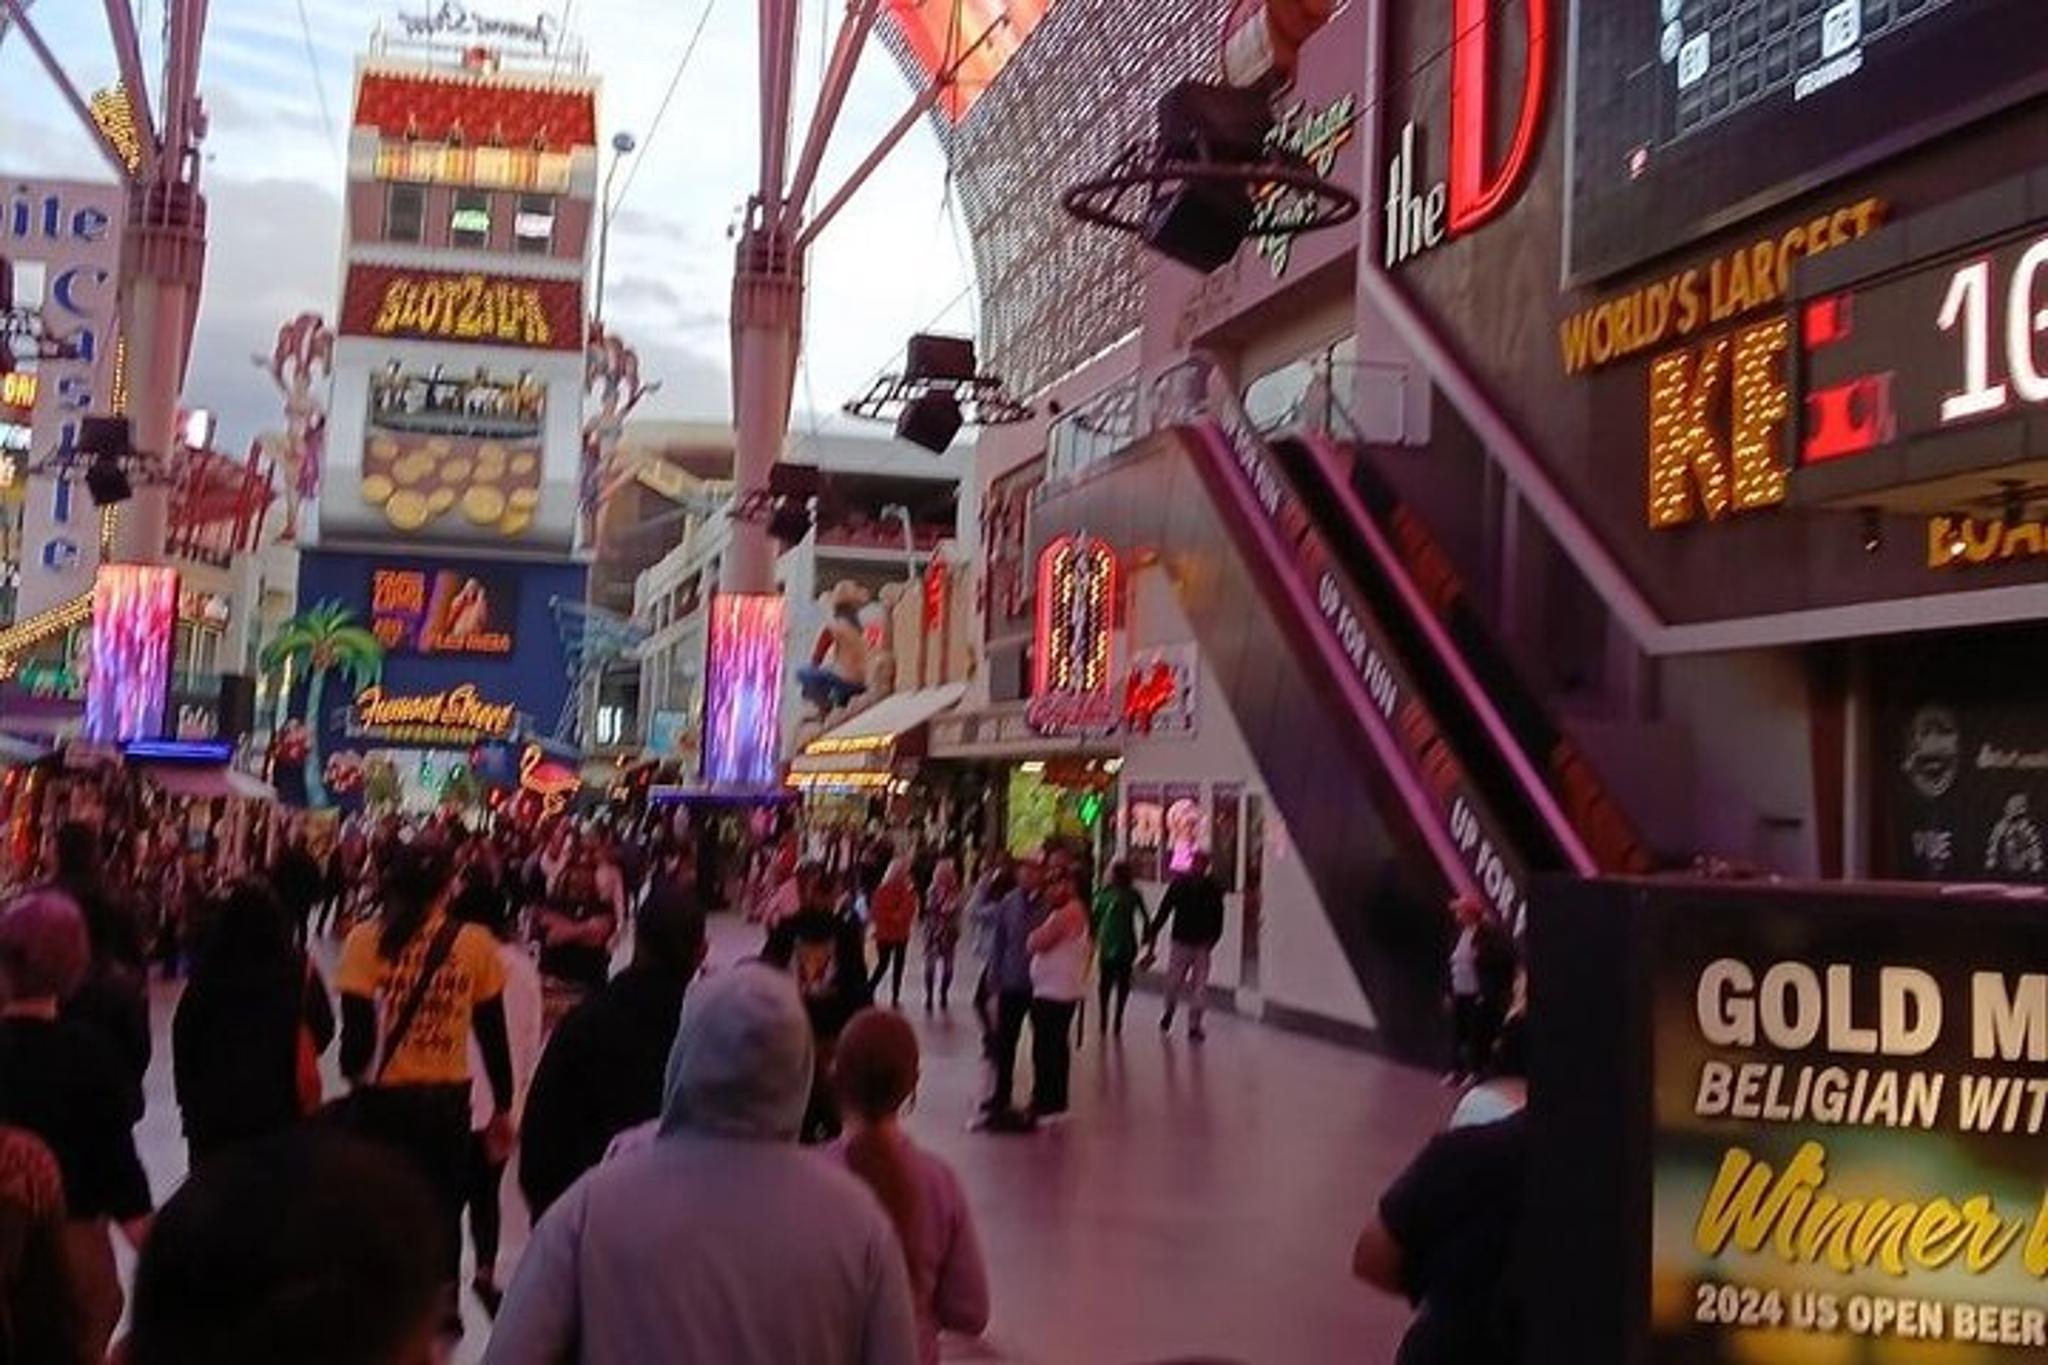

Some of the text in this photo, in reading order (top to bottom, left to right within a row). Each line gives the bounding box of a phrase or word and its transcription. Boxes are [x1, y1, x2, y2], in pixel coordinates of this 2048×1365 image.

[1385, 120, 1446, 270] the
[1449, 0, 1549, 238] D
[1562, 268, 1699, 376] WORLD'S
[1363, 650, 1397, 719] FUN
[1451, 796, 1479, 852] UP
[1697, 957, 1943, 1057] GOLD
[1695, 1061, 1944, 1129] BELIGIAN
[1697, 1140, 2023, 1276] Winner
[1696, 1284, 2047, 1346] 2024 US OPEN BEER
